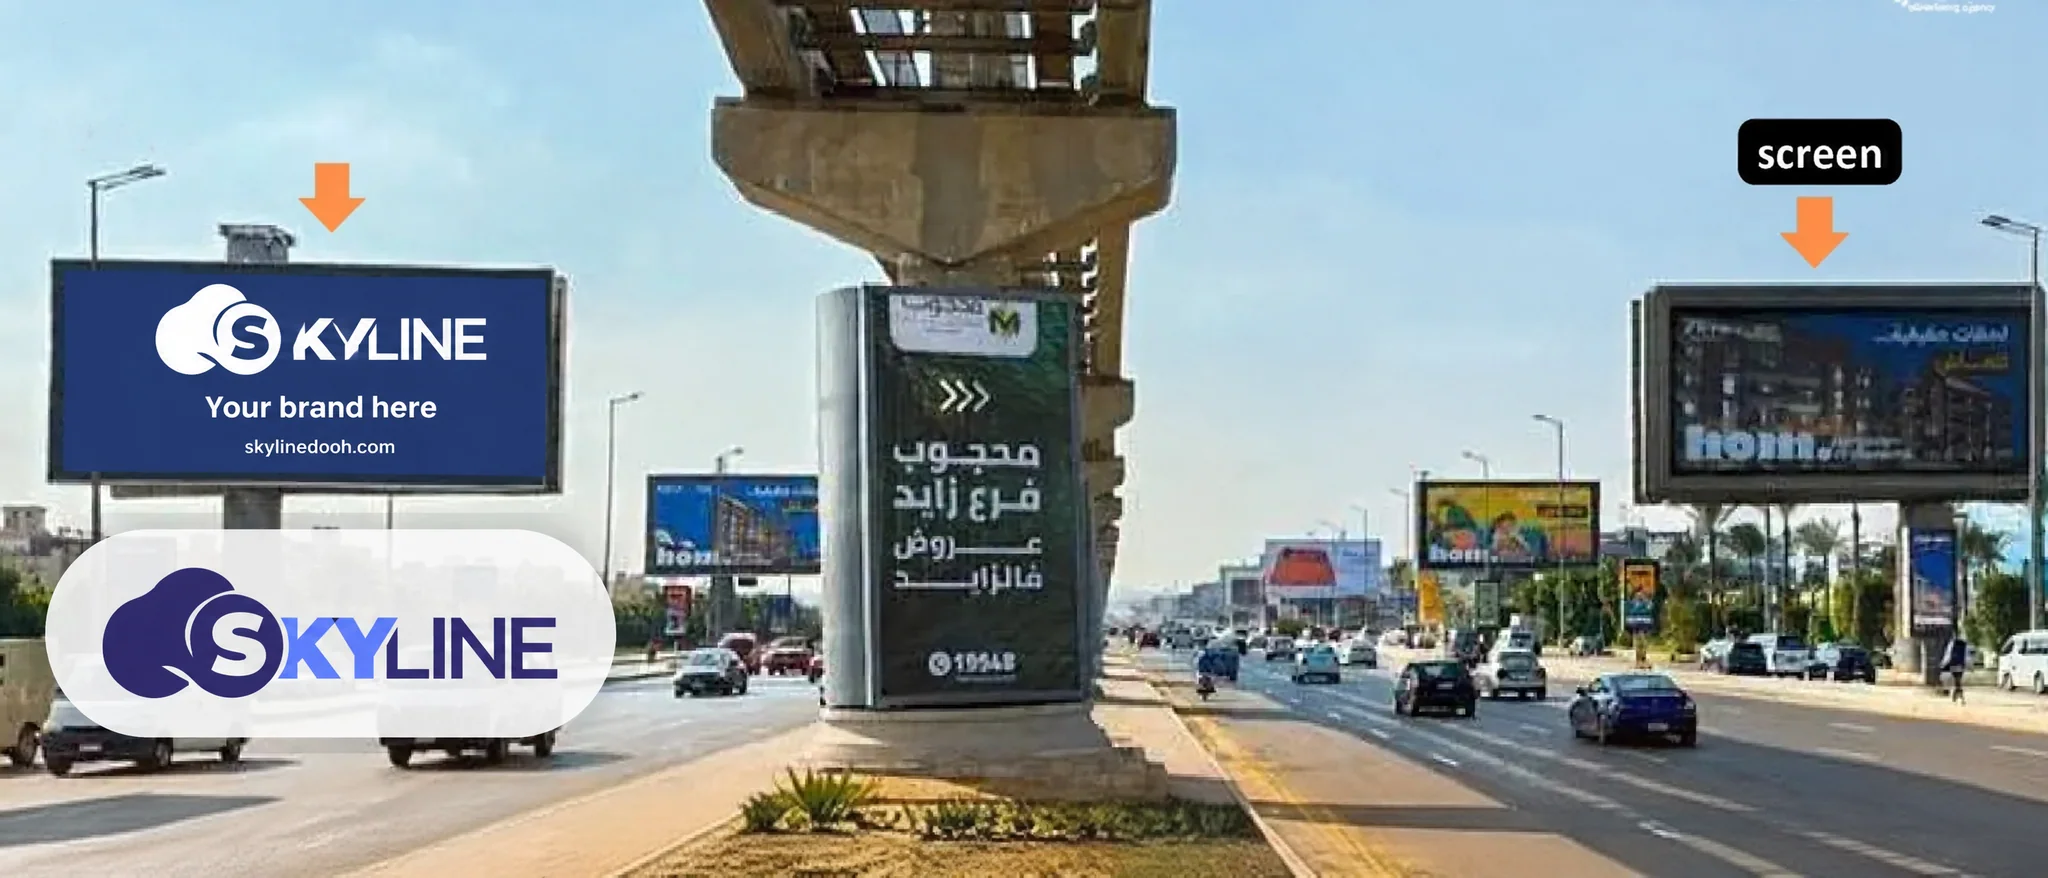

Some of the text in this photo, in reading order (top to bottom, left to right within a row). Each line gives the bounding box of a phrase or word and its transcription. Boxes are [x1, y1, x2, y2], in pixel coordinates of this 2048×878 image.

[205, 394, 438, 420] Your brand here
[244, 438, 396, 459] skylinedooh.com
[893, 440, 1041, 475] محجوب
[892, 474, 1041, 523] فرع زايد
[893, 526, 1043, 562] عروض
[893, 560, 1044, 596] فالزايد
